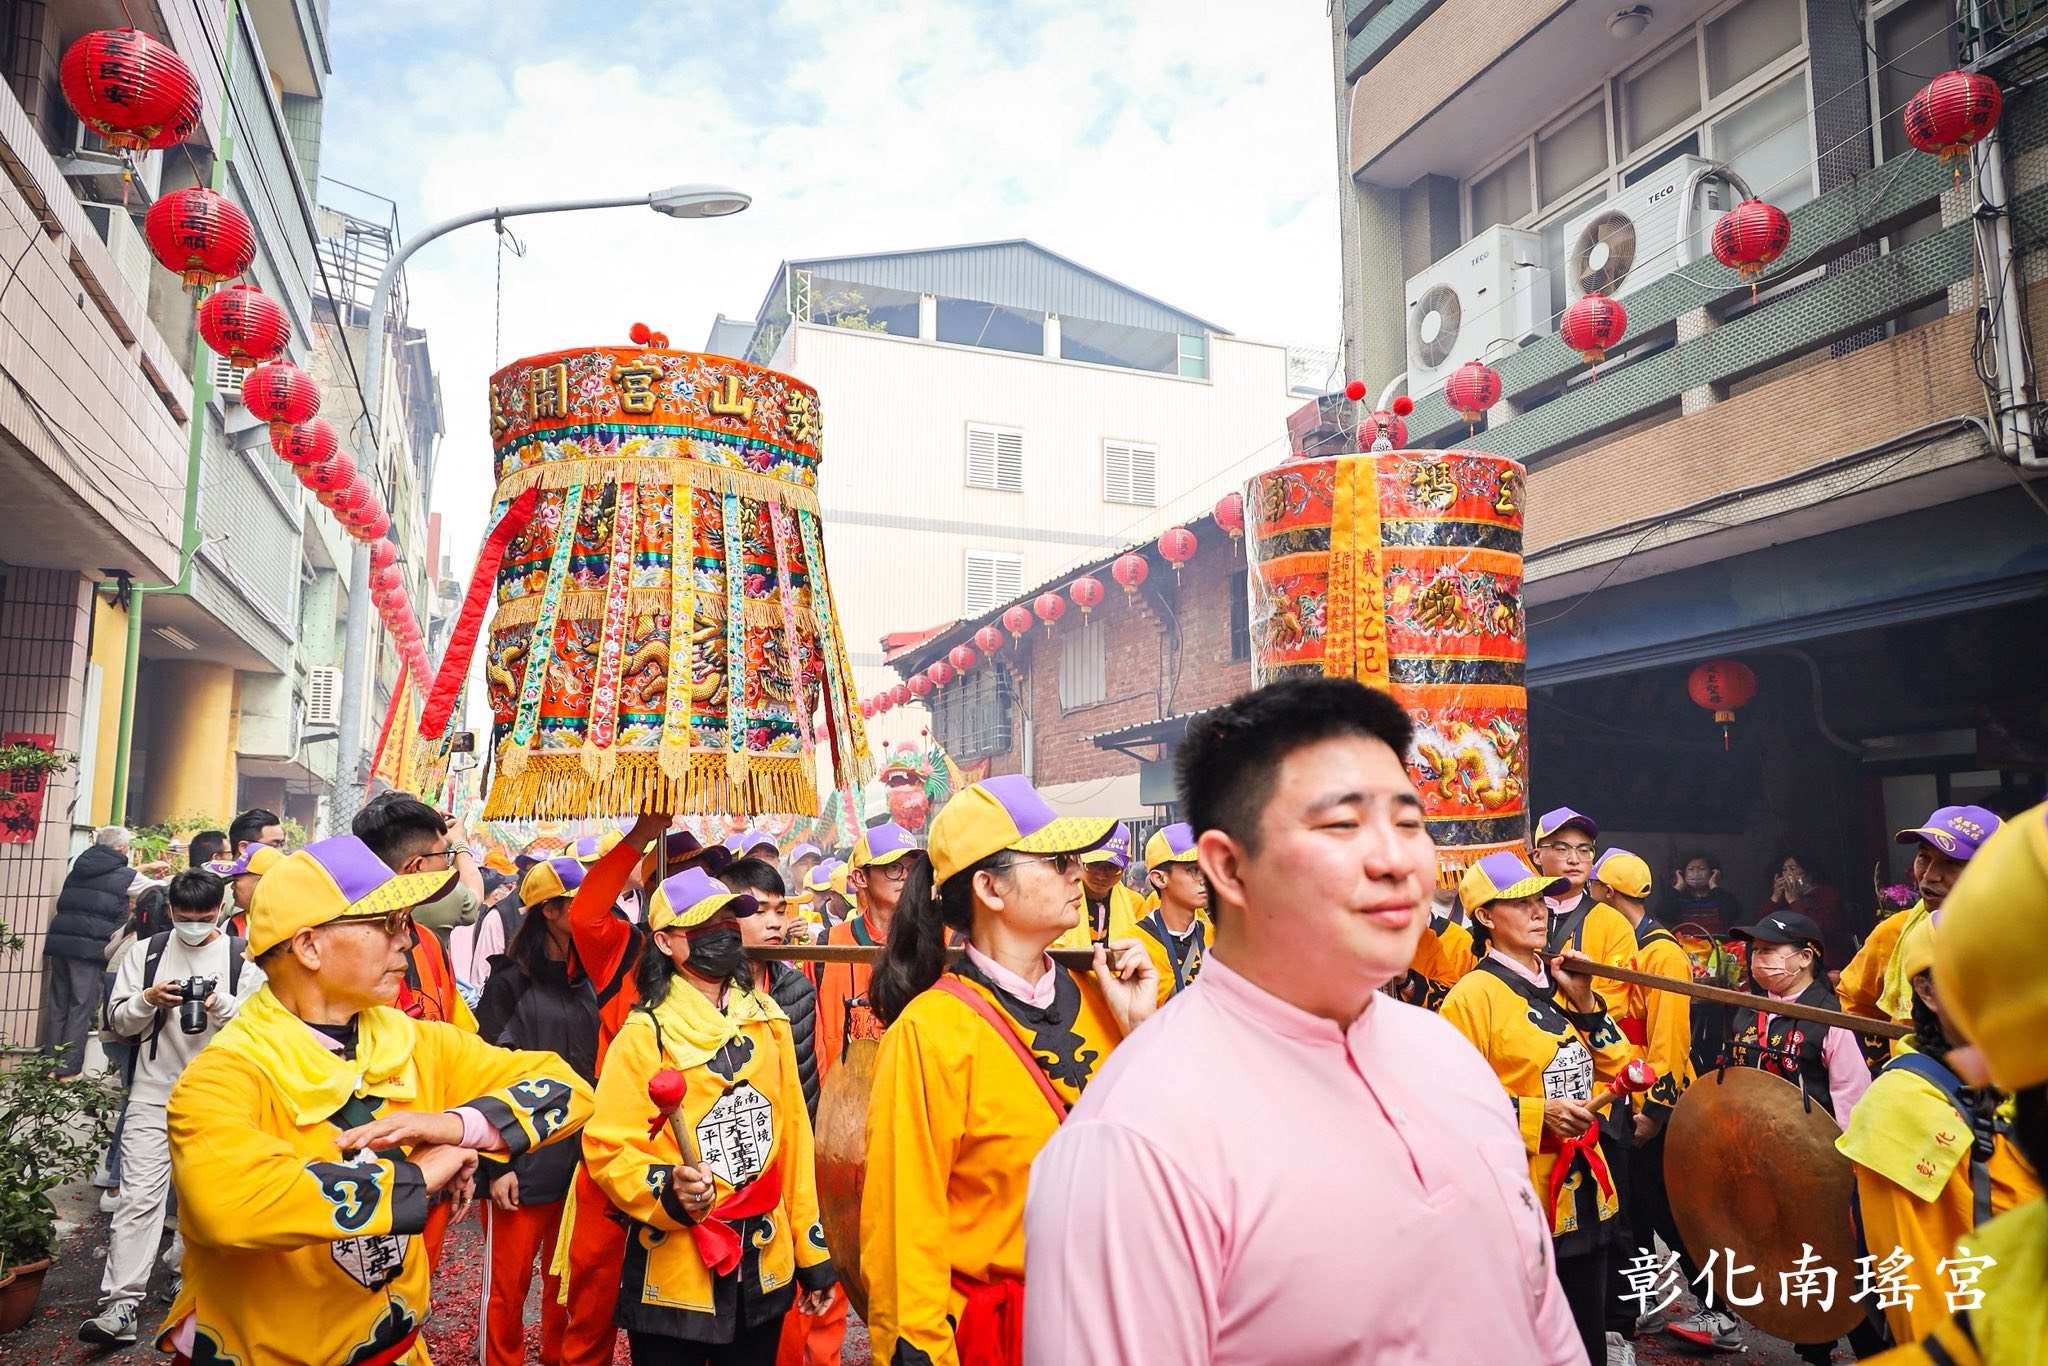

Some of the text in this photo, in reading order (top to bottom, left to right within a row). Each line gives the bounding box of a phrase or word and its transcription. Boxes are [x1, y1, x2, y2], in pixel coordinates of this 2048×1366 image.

[1648, 184, 1674, 204] TECO
[1471, 251, 1489, 266] TECO
[755, 1111, 771, 1143] 合境
[701, 1128, 722, 1165] 平安
